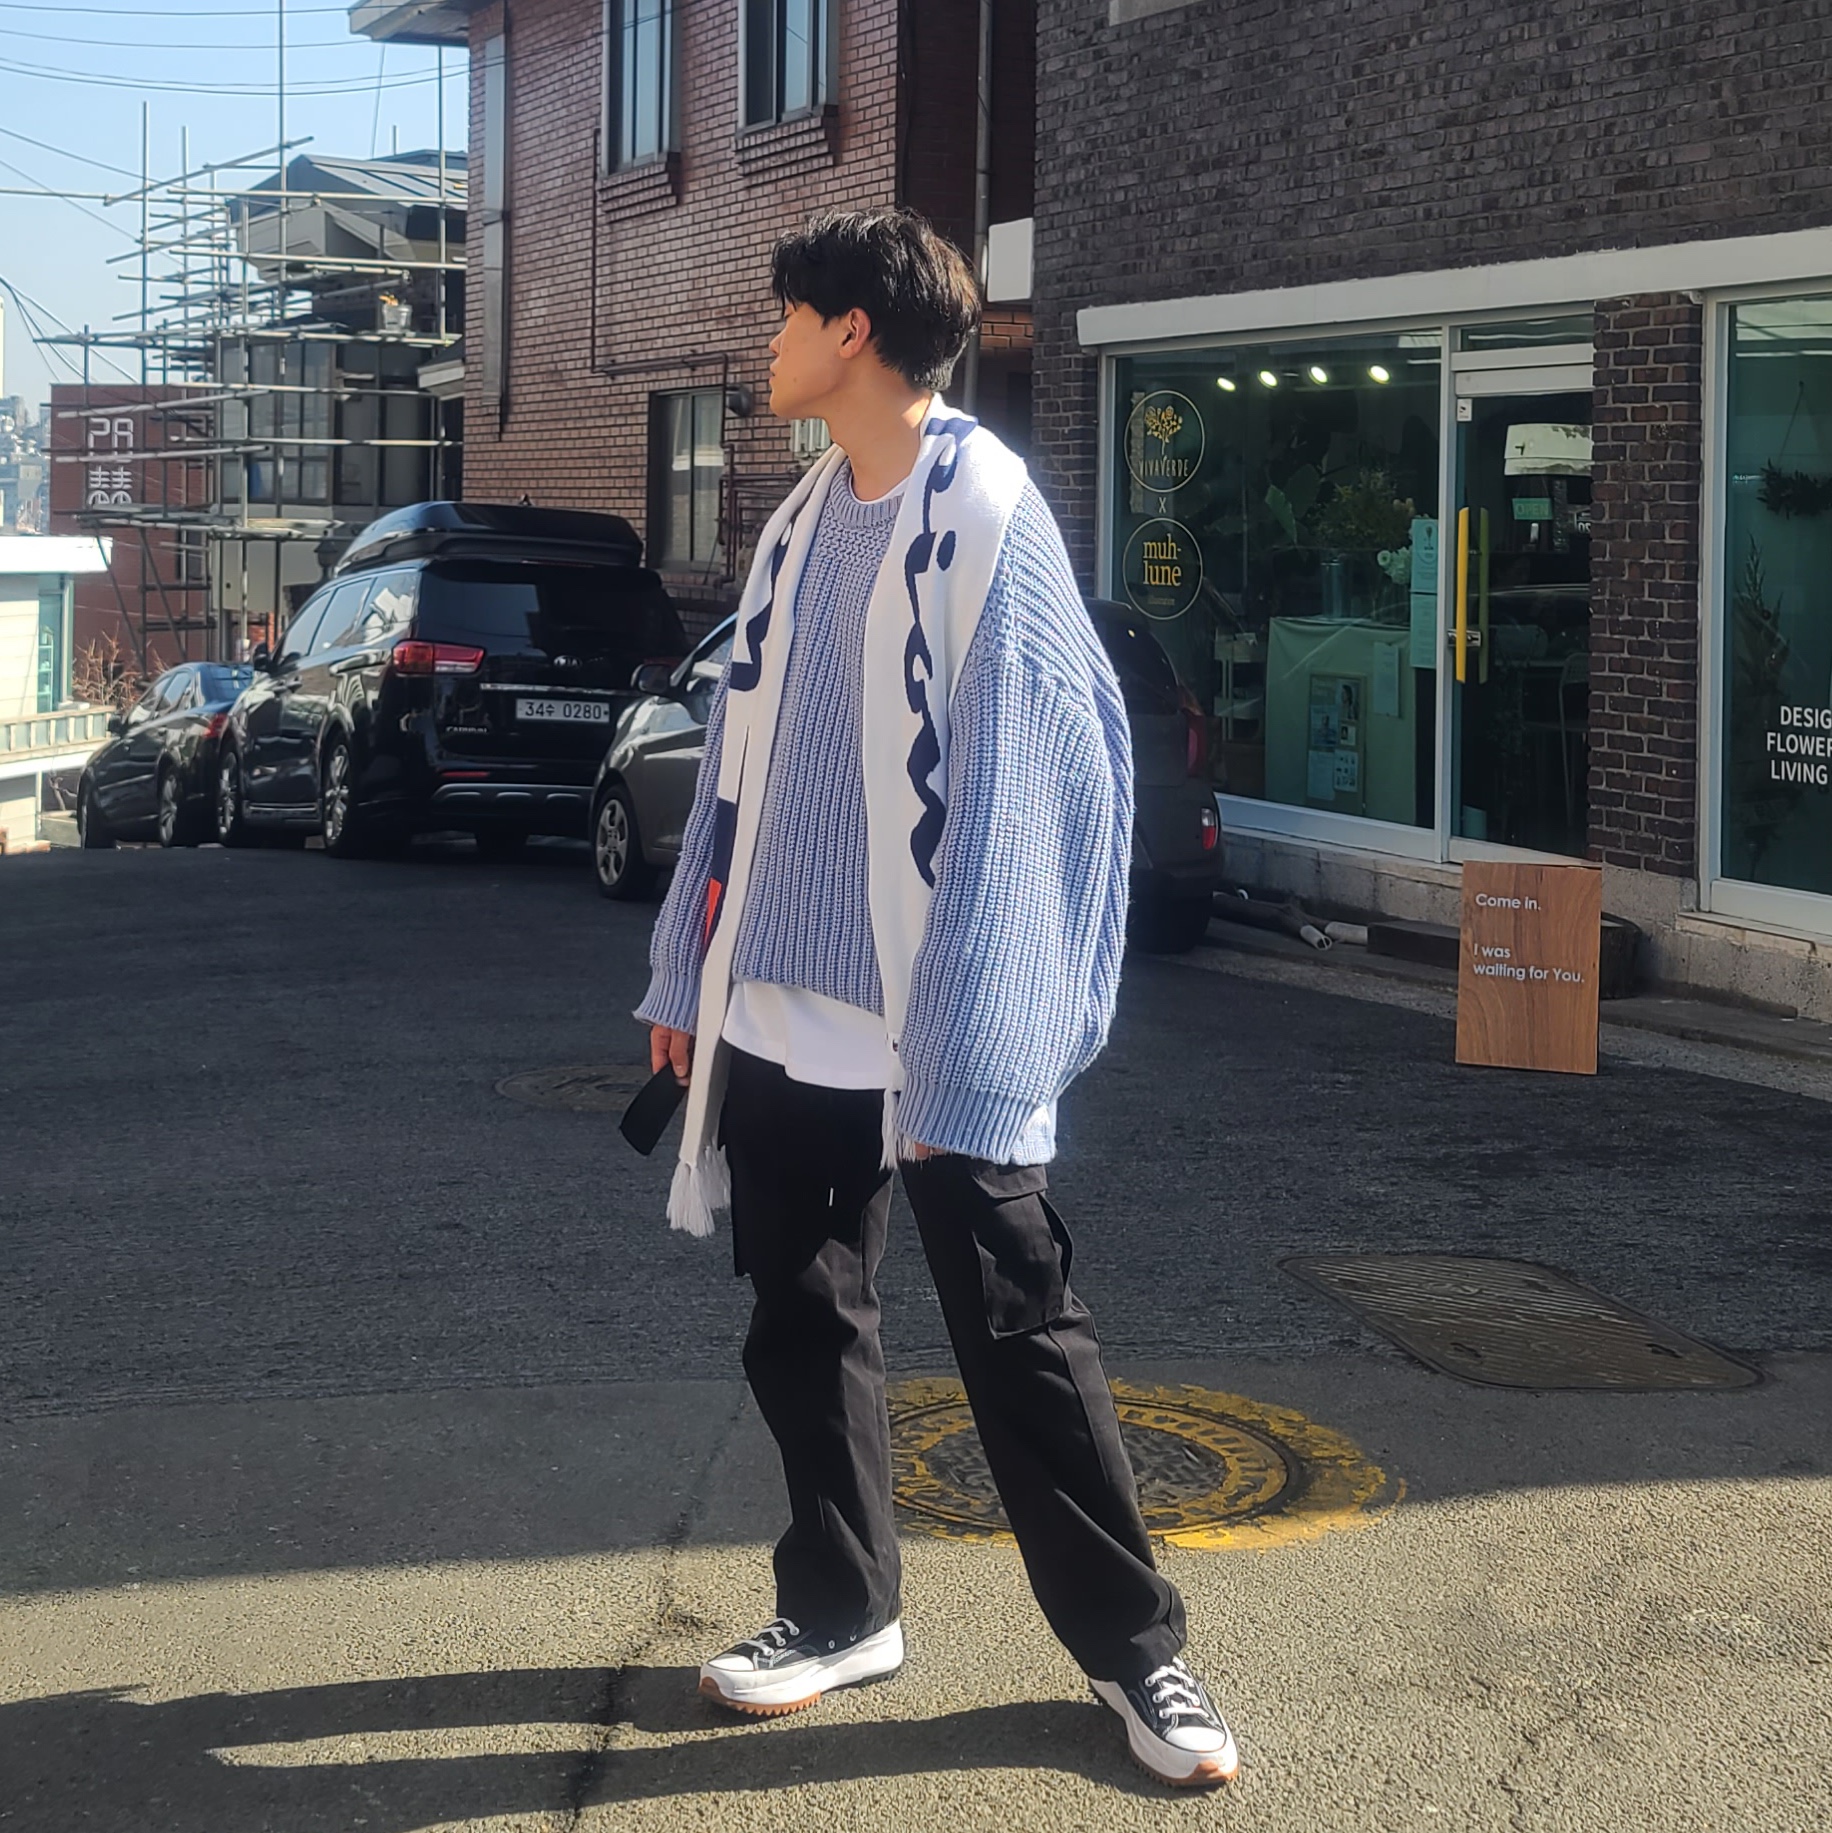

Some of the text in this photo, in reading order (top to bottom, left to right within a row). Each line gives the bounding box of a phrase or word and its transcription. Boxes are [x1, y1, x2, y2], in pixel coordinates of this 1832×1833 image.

[1138, 456, 1189, 477] VIVAVERDE
[1516, 503, 1549, 516] OPEN
[1142, 533, 1182, 560] muh-
[1142, 560, 1182, 587] lune
[525, 701, 602, 720] 34수 0280
[1770, 759, 1828, 785] LIVING
[1475, 893, 1542, 911] Come in.
[1473, 943, 1511, 959] I was
[1473, 963, 1585, 983] waiting for You.
